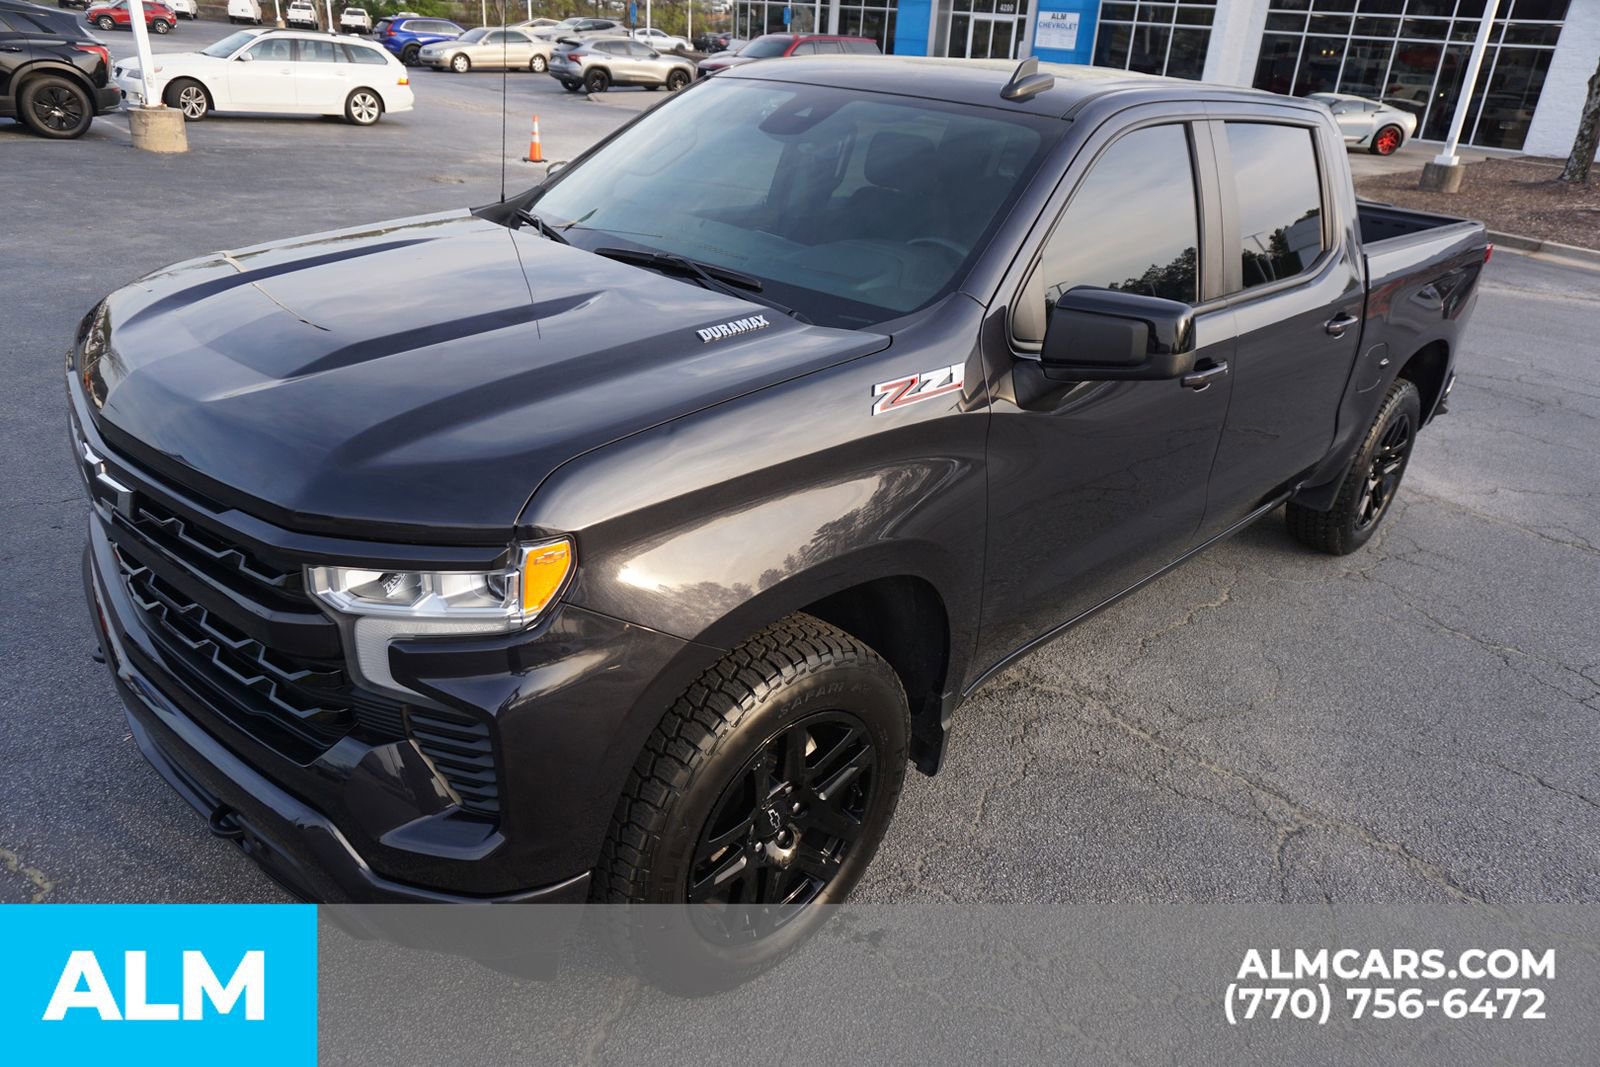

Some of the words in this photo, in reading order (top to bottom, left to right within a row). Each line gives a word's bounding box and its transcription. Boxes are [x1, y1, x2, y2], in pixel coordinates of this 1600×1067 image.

[1038, 21, 1078, 30] CHEVROLET
[697, 314, 770, 343] DURAMAX
[872, 362, 965, 416] Z71
